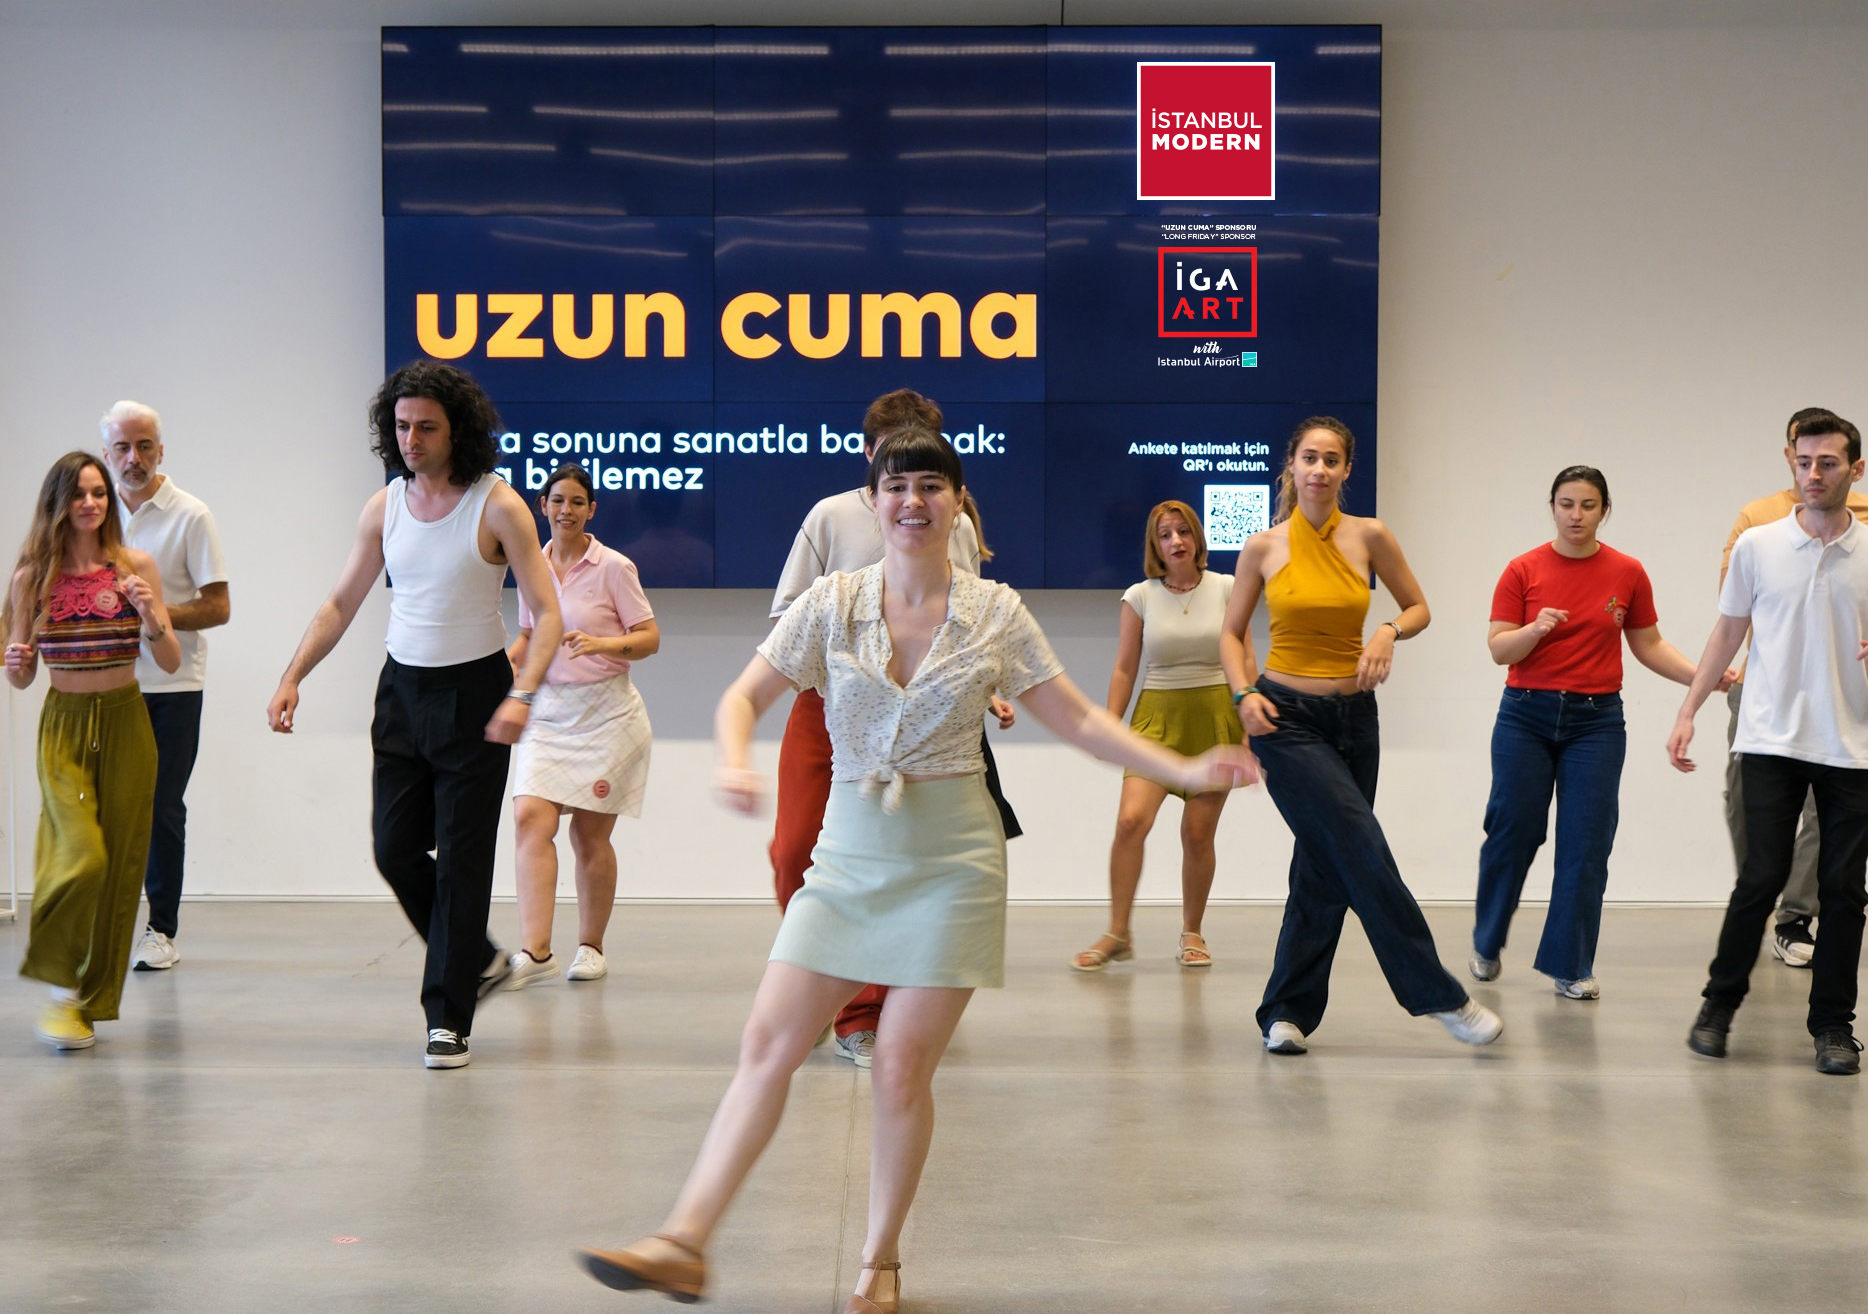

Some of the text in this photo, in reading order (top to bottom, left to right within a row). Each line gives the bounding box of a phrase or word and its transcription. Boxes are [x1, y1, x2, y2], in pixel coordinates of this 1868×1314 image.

[1151, 108, 1263, 129] İSTANBUL
[1151, 133, 1261, 150] MODERN
[1171, 296, 1244, 320] ART
[416, 292, 1037, 360] uzun cuma
[1192, 340, 1223, 354] with
[1157, 356, 1201, 367] Istanbul
[1203, 355, 1241, 368] Airport
[532, 431, 661, 454] sonuna
[672, 423, 808, 454] sanatla
[820, 423, 1006, 454] baak:
[1127, 441, 1270, 457] Ankete katılmak için
[1216, 458, 1270, 472] okutun.
